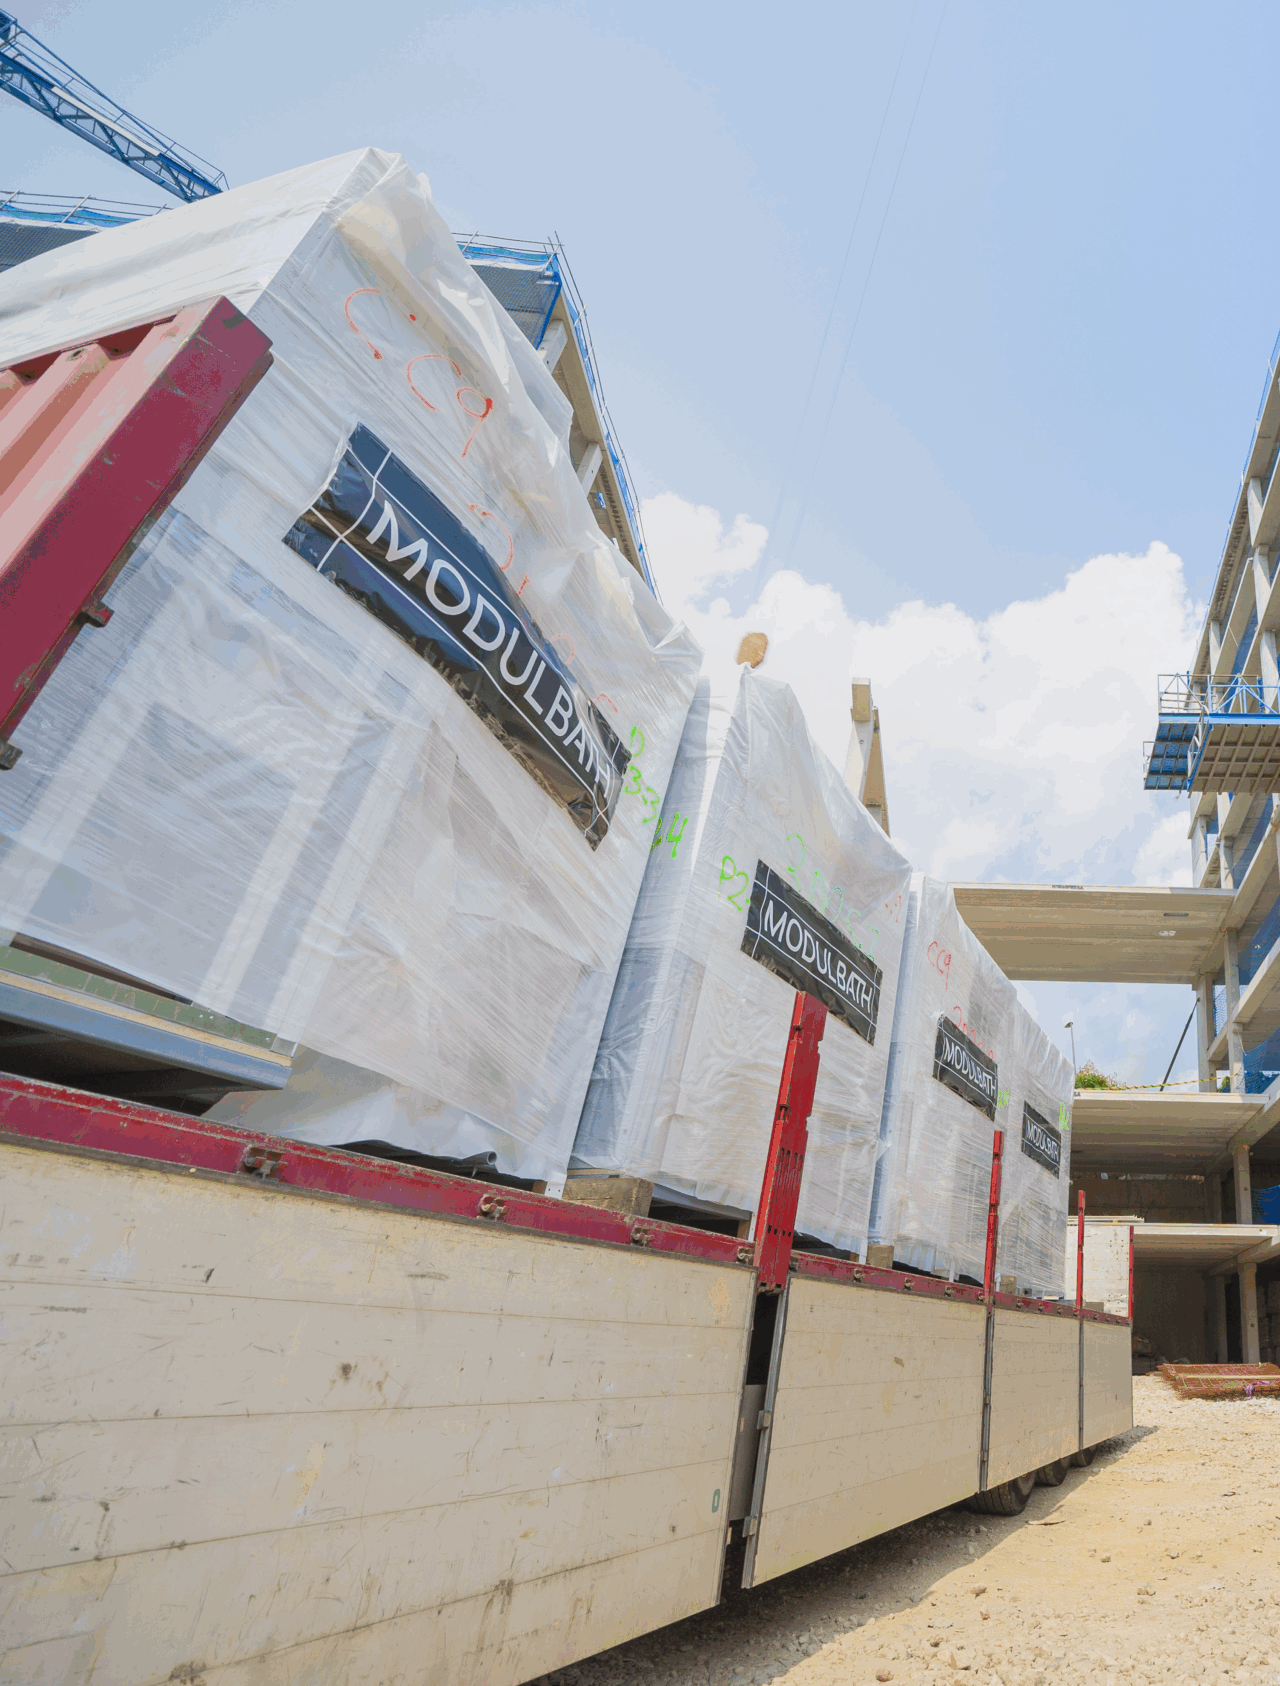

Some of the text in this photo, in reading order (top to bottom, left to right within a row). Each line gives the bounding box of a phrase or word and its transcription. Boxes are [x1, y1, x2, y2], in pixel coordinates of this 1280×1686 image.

[366, 501, 613, 798] MODULBATH
[765, 901, 873, 1013] MODULBATH
[943, 1037, 996, 1097] MODULBATH
[1027, 1121, 1060, 1161] MODULBATH
